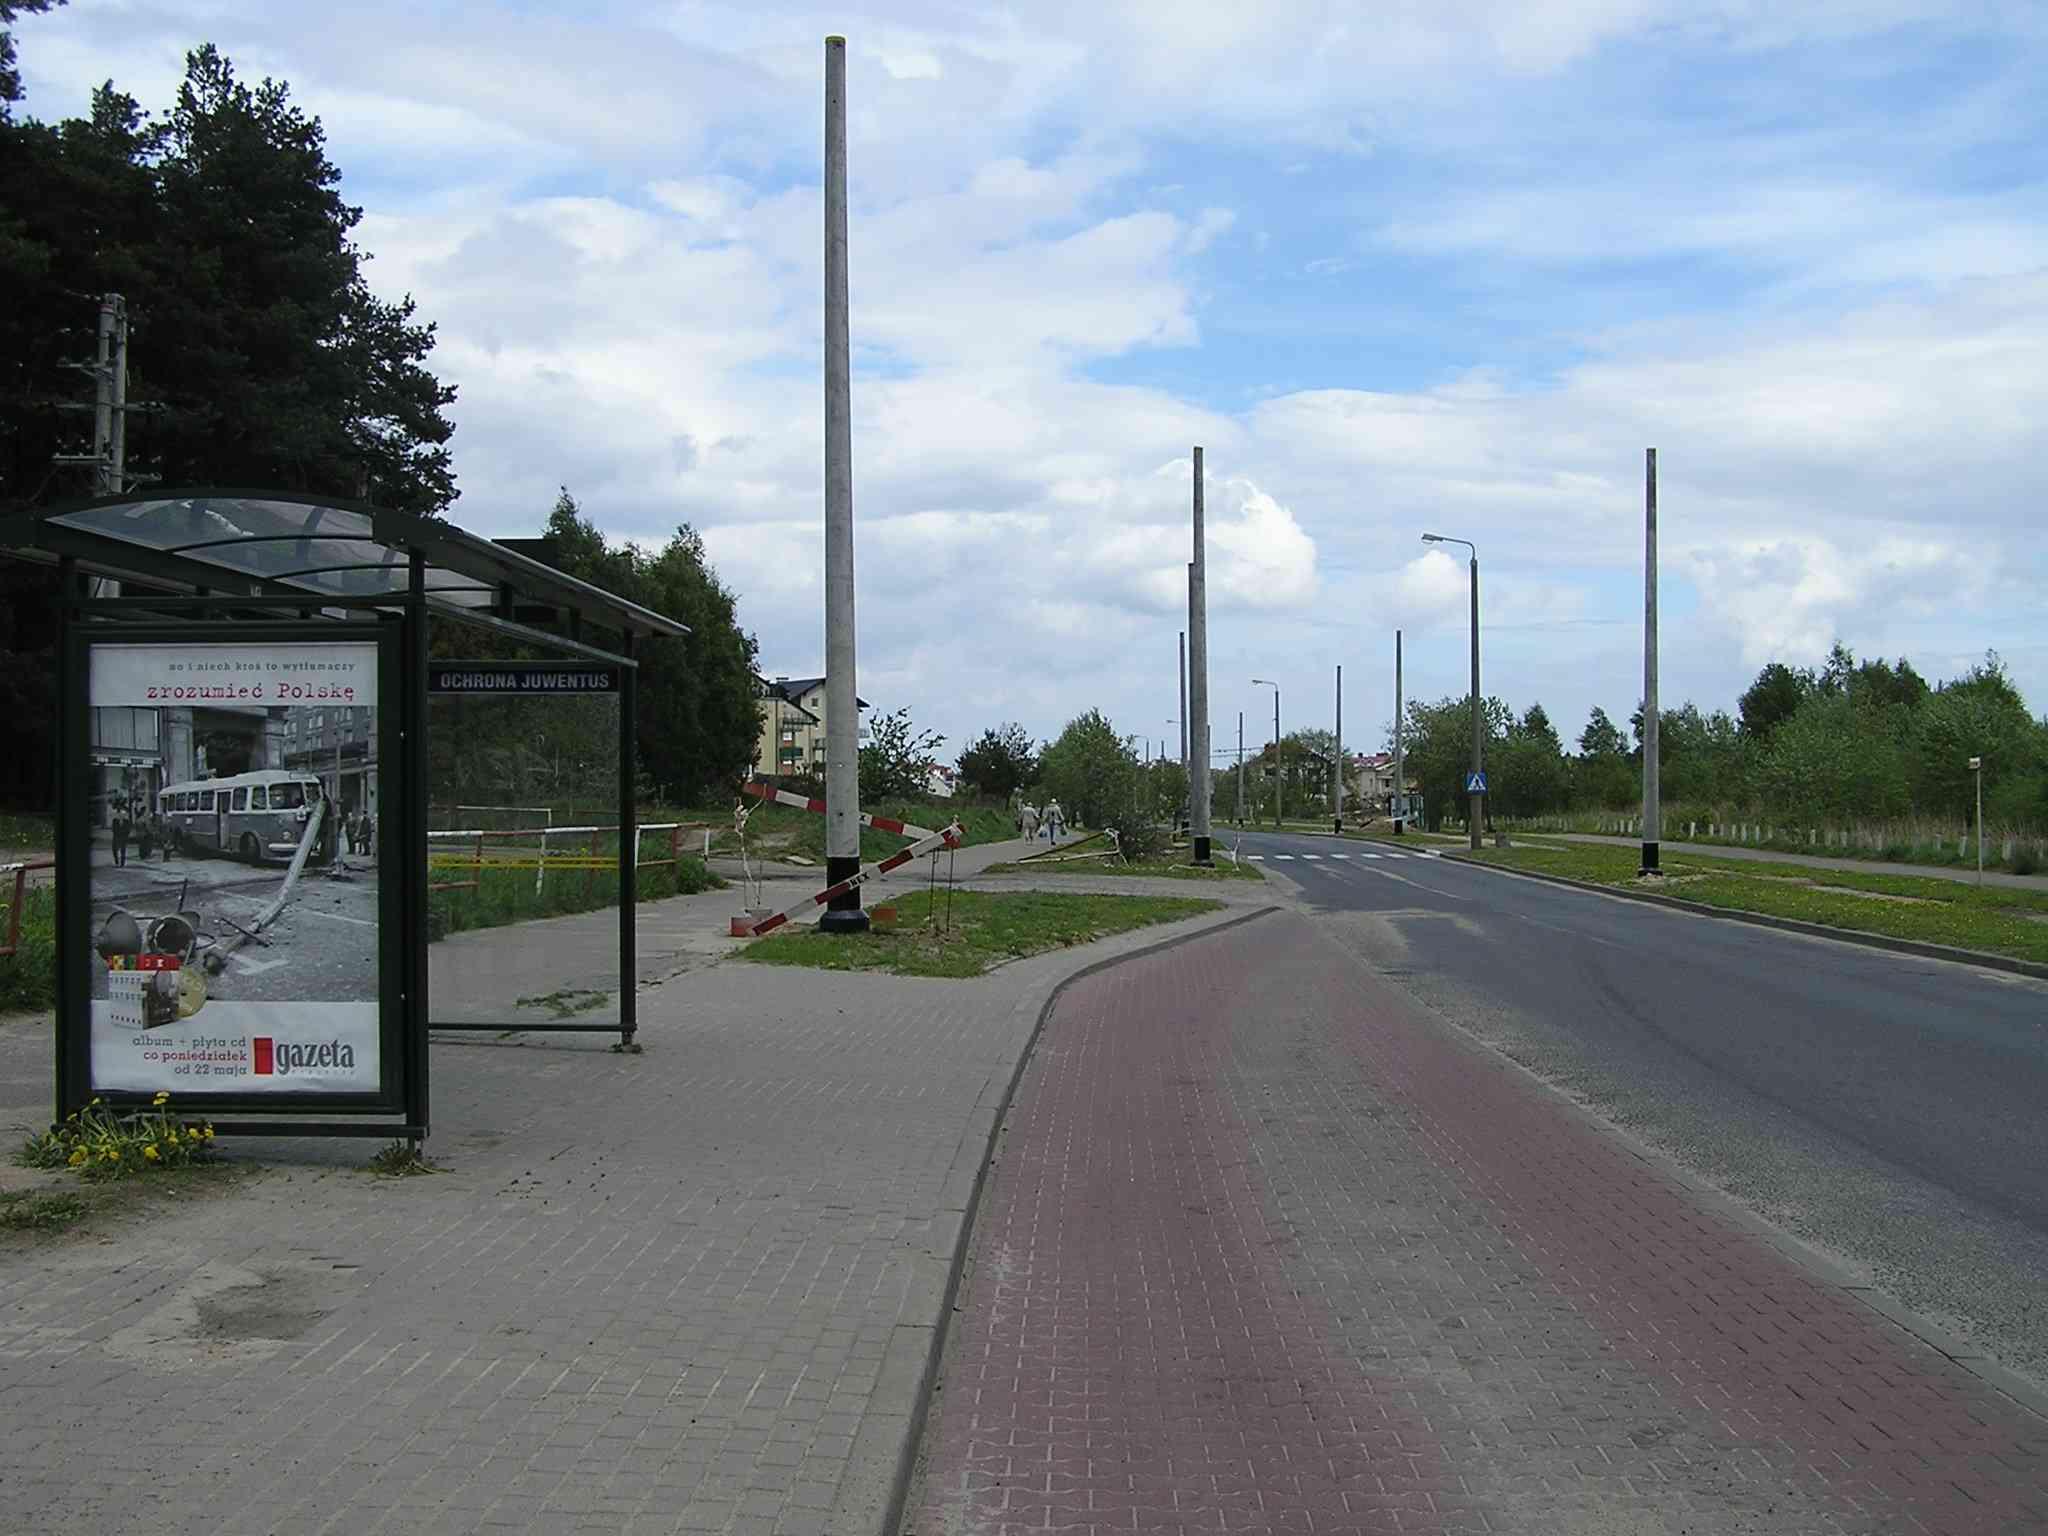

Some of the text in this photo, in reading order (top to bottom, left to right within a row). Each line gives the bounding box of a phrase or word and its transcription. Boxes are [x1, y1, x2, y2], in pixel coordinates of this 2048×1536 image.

[197, 662, 231, 671] niech
[266, 662, 279, 671] to
[440, 673, 609, 688] OCHRONA JUWENTUS
[147, 682, 354, 702] zrozumieć Polskę
[132, 1035, 173, 1047] album
[192, 1035, 226, 1050] płyta
[230, 1036, 247, 1047] cd
[143, 1050, 247, 1063] co poniedziałek
[276, 1039, 355, 1075] gazeta
[174, 1063, 247, 1078] od 22 maja
